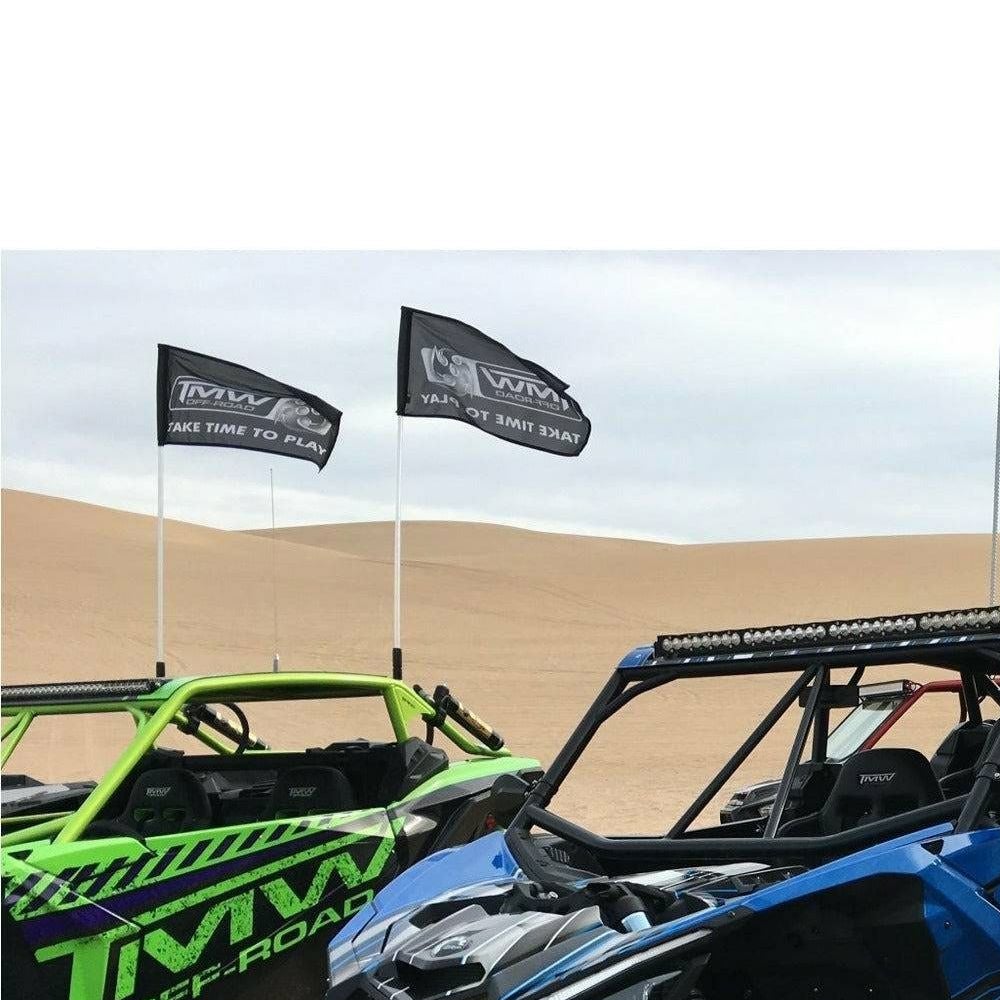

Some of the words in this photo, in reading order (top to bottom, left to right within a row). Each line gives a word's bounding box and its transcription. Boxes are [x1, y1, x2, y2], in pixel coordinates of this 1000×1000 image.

[178, 381, 275, 406] TMW
[186, 399, 255, 412] OFF-ROAD
[168, 422, 200, 433] TAKE
[206, 422, 247, 436] TIME
[253, 427, 278, 440] TO
[284, 434, 327, 455] PLAY
[860, 772, 896, 784] TMW
